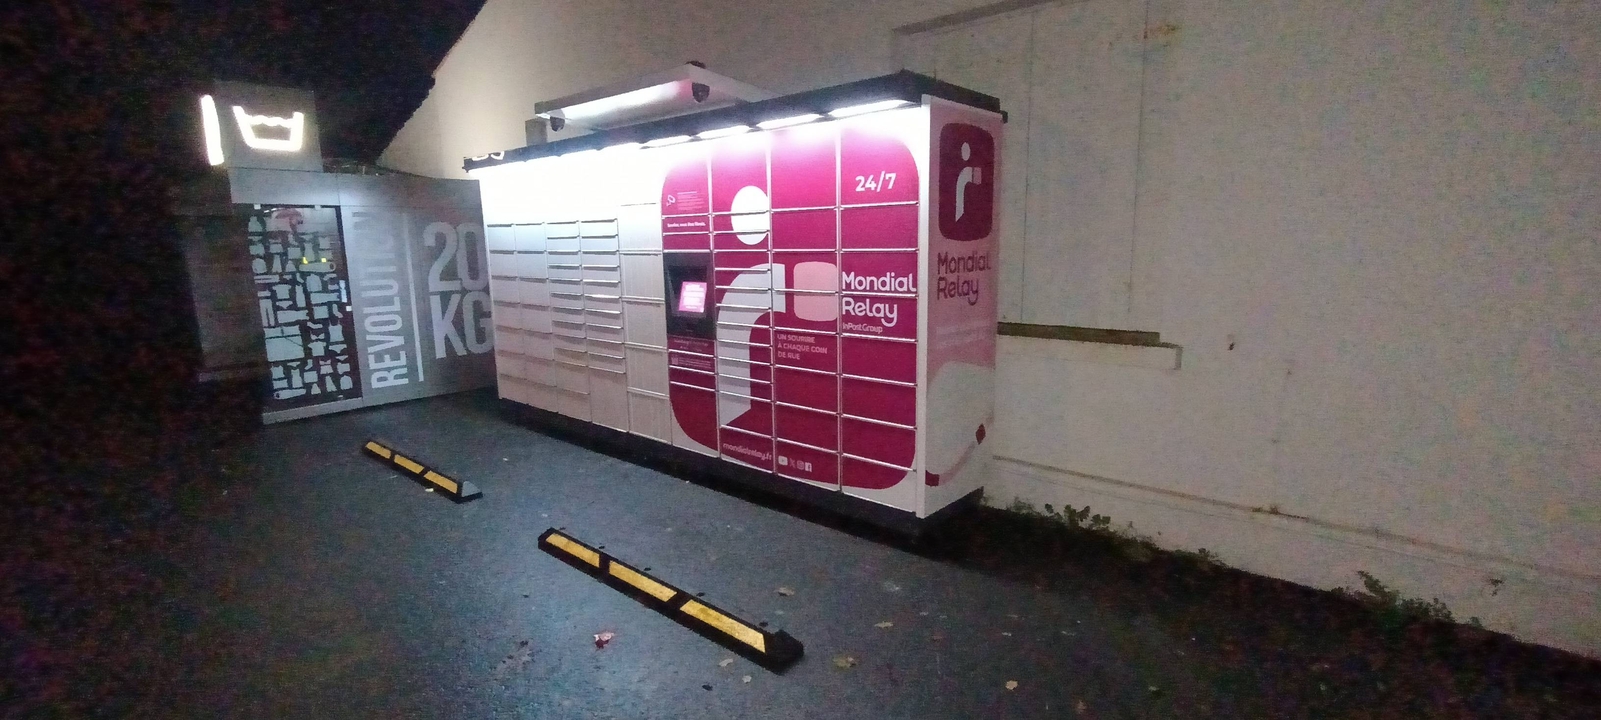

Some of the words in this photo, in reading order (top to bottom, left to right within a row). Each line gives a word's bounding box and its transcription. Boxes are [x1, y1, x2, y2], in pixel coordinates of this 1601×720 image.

[855, 171, 896, 192] 24/7
[423, 222, 488, 292] 20
[937, 251, 991, 274] Mondial
[842, 271, 917, 292] Mondial
[937, 276, 980, 306] Relay
[842, 297, 898, 327] Relay
[430, 292, 494, 359] KG
[862, 323, 883, 334] Group
[783, 343, 809, 352] CHAQUE
[811, 345, 828, 354] COIN
[788, 334, 815, 343] SOURIRE
[788, 352, 800, 360] RUE
